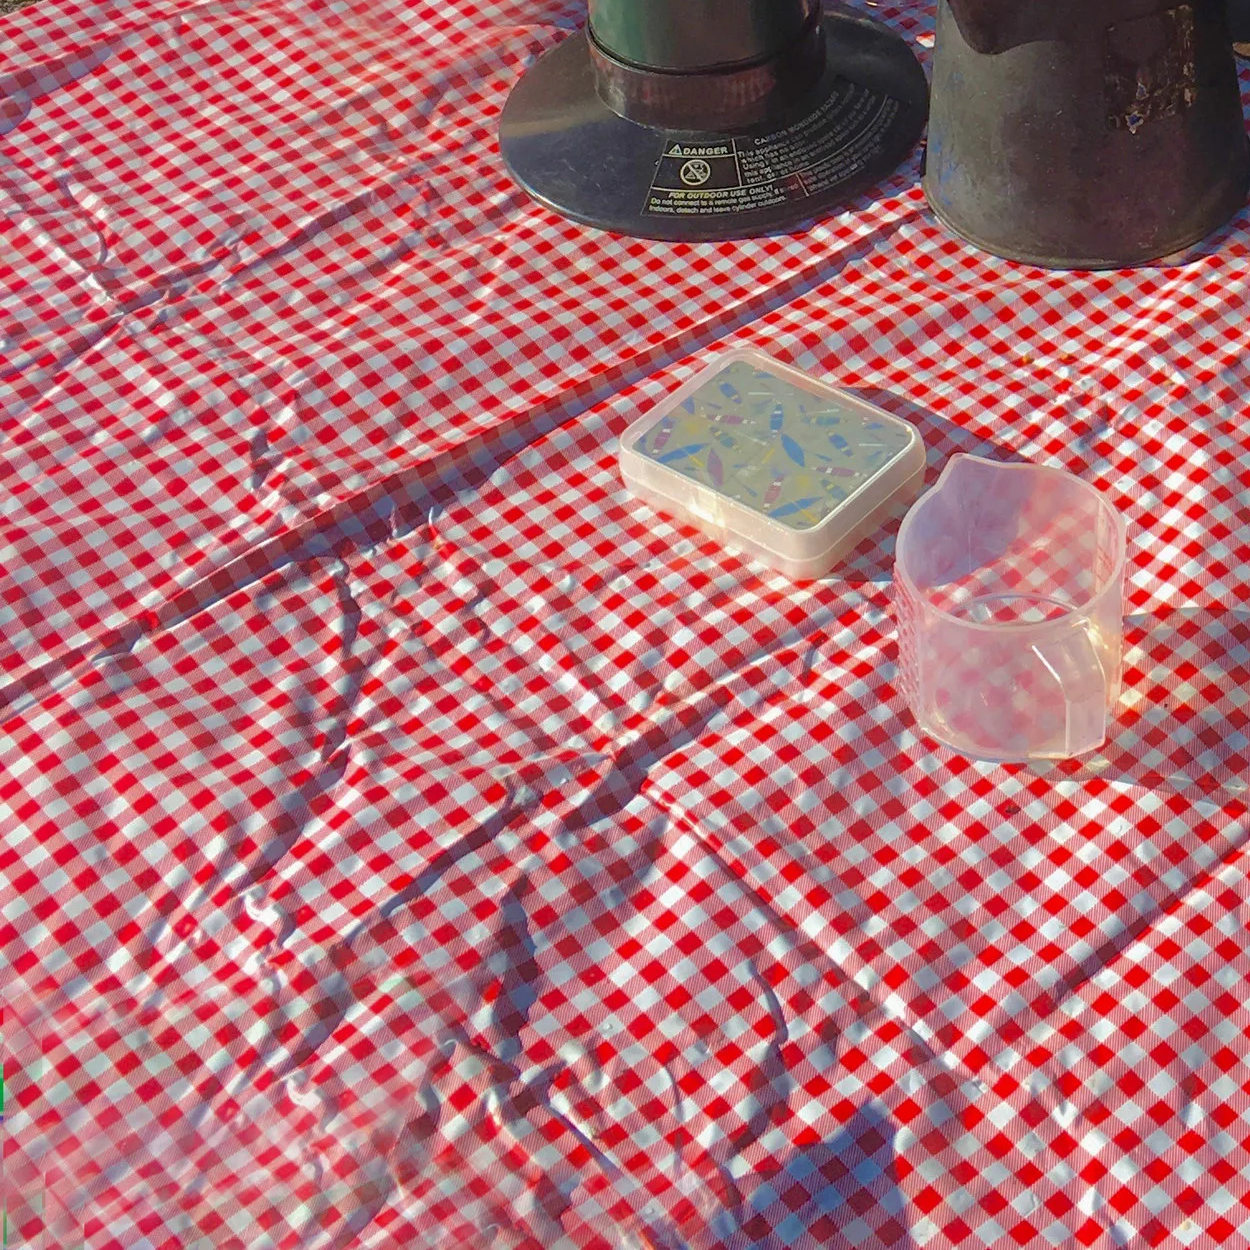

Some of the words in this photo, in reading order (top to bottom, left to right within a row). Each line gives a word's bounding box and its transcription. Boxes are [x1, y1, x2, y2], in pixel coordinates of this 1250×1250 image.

[683, 146, 728, 156] DANGER
[668, 191, 687, 199] FOR
[687, 191, 729, 200] OUTDOOR
[730, 189, 747, 198] USE
[748, 184, 774, 195] ONLY!
[699, 205, 713, 214] and
